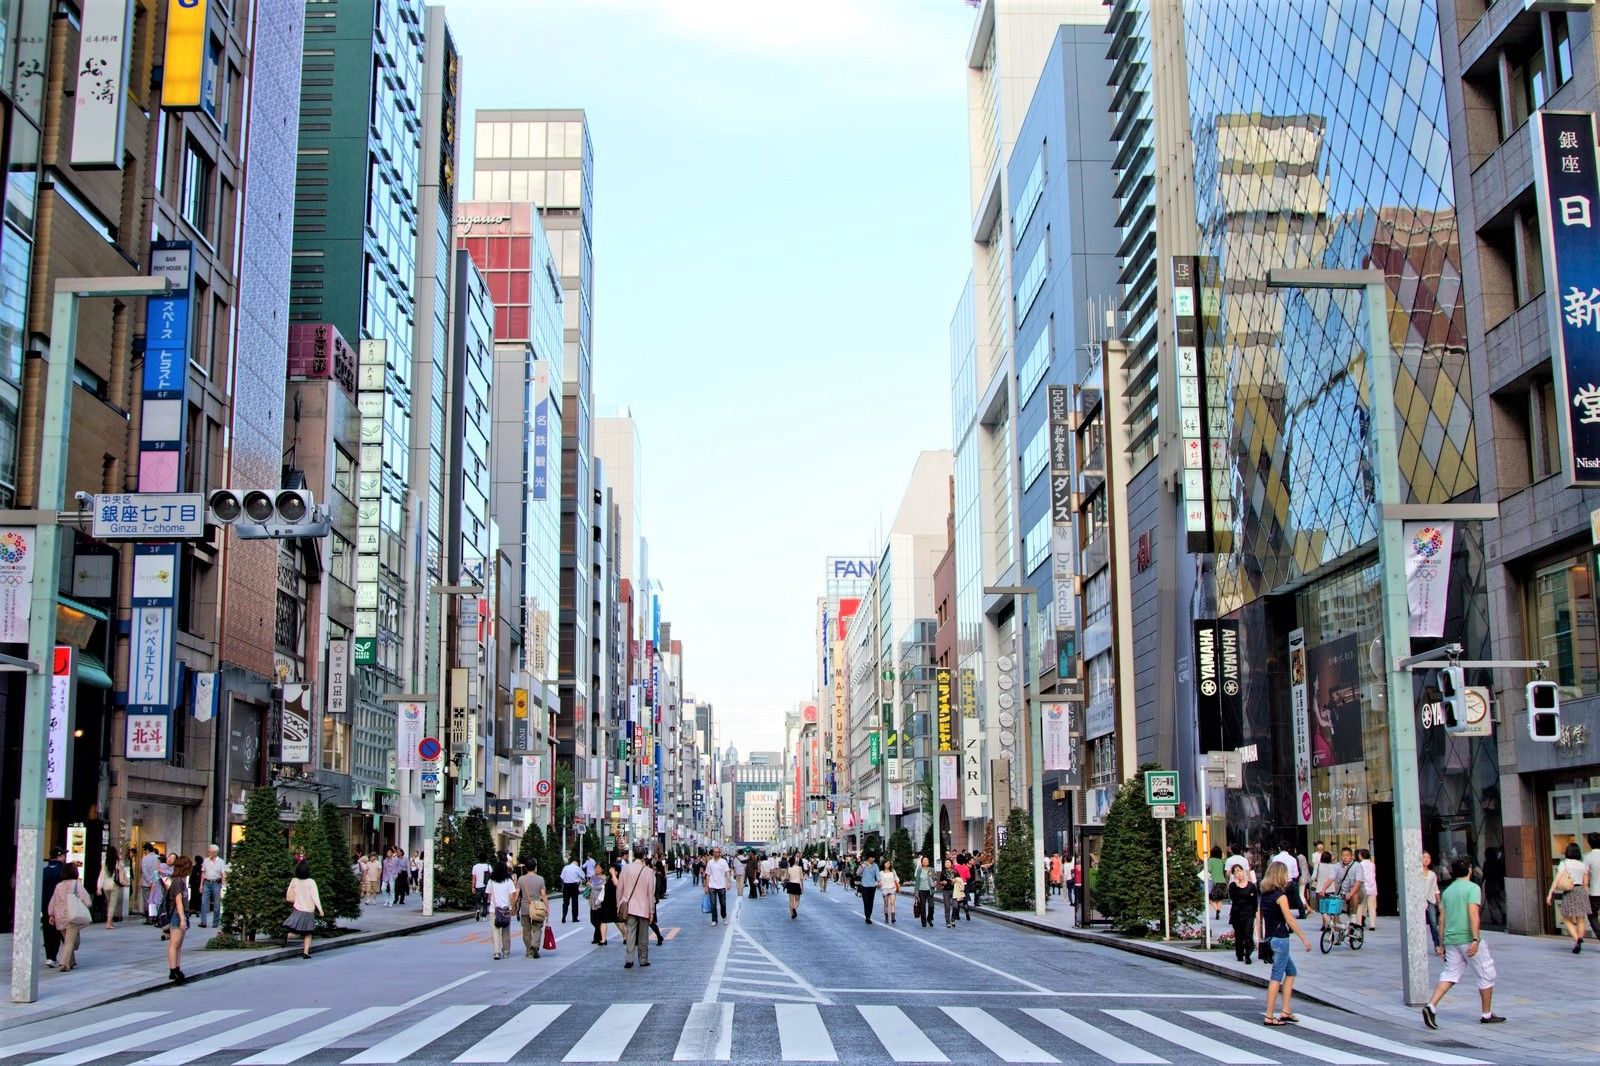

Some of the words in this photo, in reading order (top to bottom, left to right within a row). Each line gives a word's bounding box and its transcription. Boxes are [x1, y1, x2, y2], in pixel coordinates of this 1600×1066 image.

[1559, 131, 1581, 173] 銀座
[160, 302, 175, 340] スペース
[1559, 195, 1600, 424] 日新堂
[158, 349, 173, 390] トラスト
[535, 415, 547, 487] 名鉄観光
[101, 496, 132, 504] 中央区
[101, 504, 197, 522] 銀座七丁目
[1053, 476, 1070, 521] ダンス
[110, 523, 138, 533] Ginza
[142, 523, 185, 533] 7-chome
[834, 560, 879, 578] FAN
[1057, 552, 1070, 573] Dr.
[1058, 578, 1072, 626] Recella
[144, 637, 156, 701] ベルエトワール
[1199, 628, 1215, 680] YAMAHA
[132, 728, 163, 744] 北斗
[966, 738, 979, 796] ZARA
